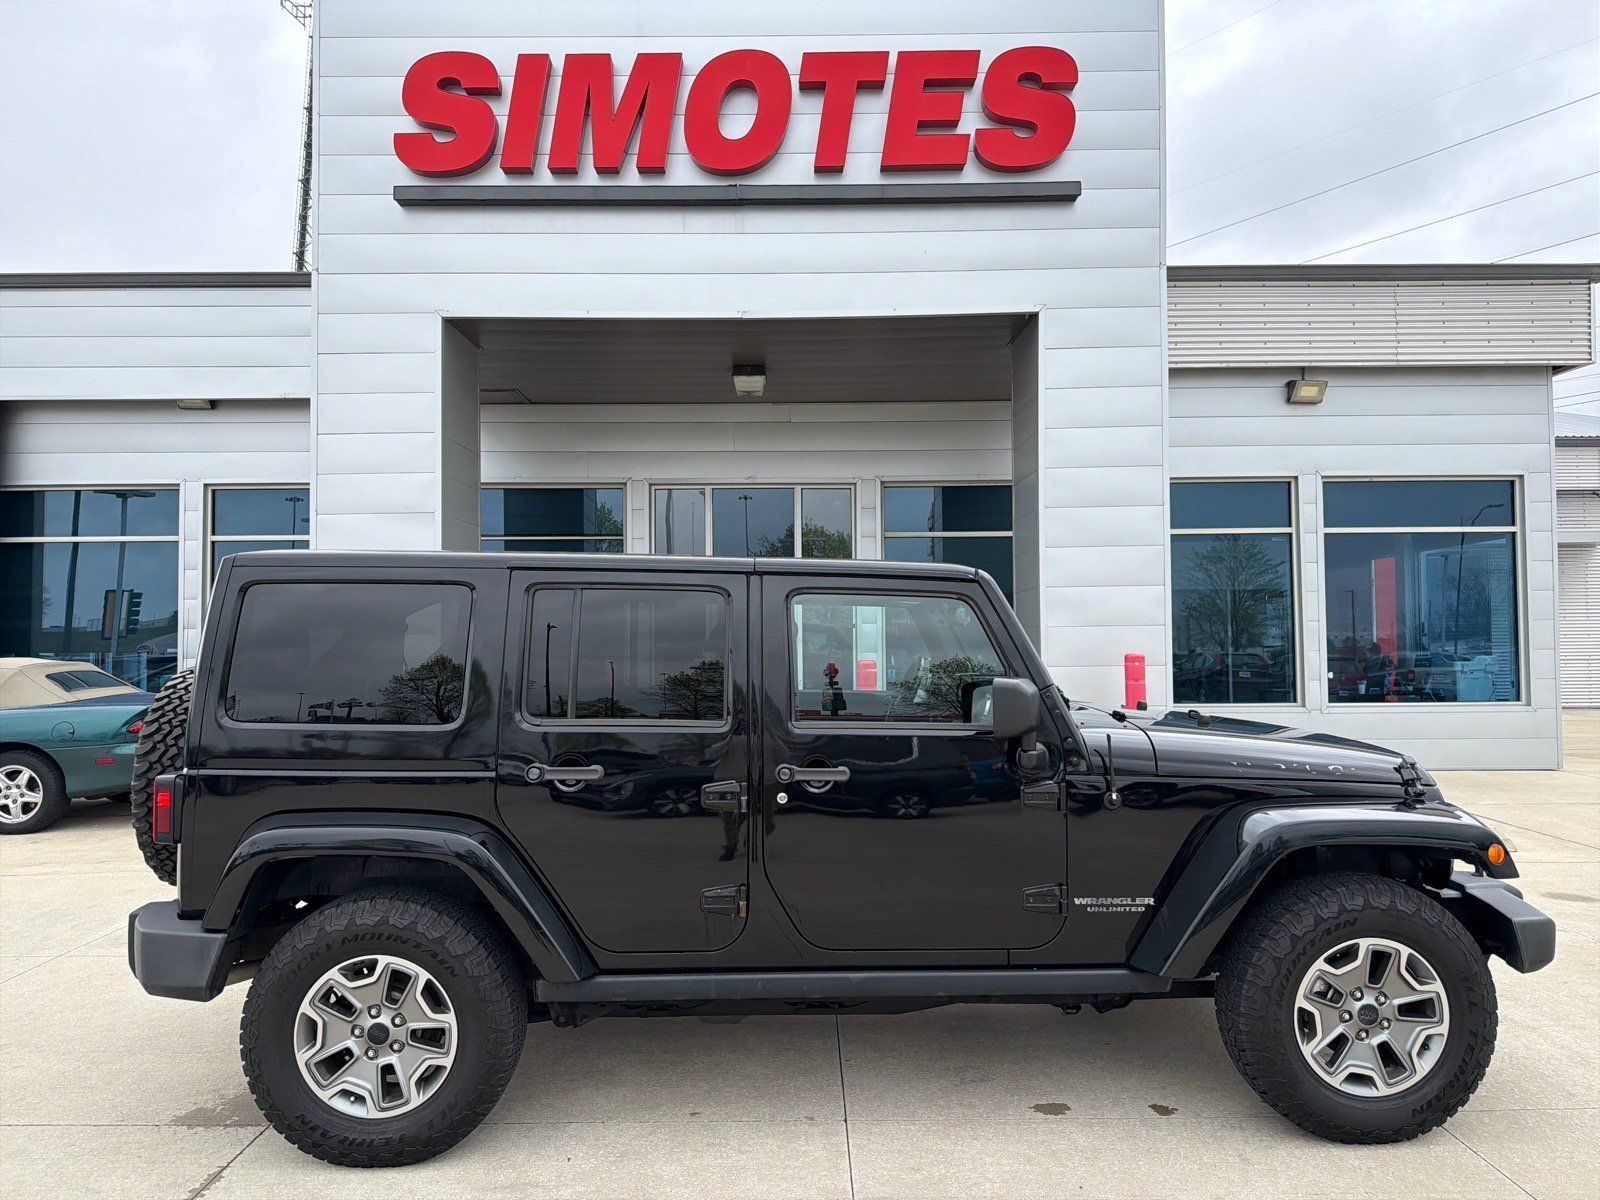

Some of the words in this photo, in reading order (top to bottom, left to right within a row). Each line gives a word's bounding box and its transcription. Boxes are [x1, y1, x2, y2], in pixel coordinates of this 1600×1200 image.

[393, 46, 1078, 177] SIMOTES
[1073, 897, 1155, 905] WRANGLER
[338, 930, 462, 980] MOUNTAIN
